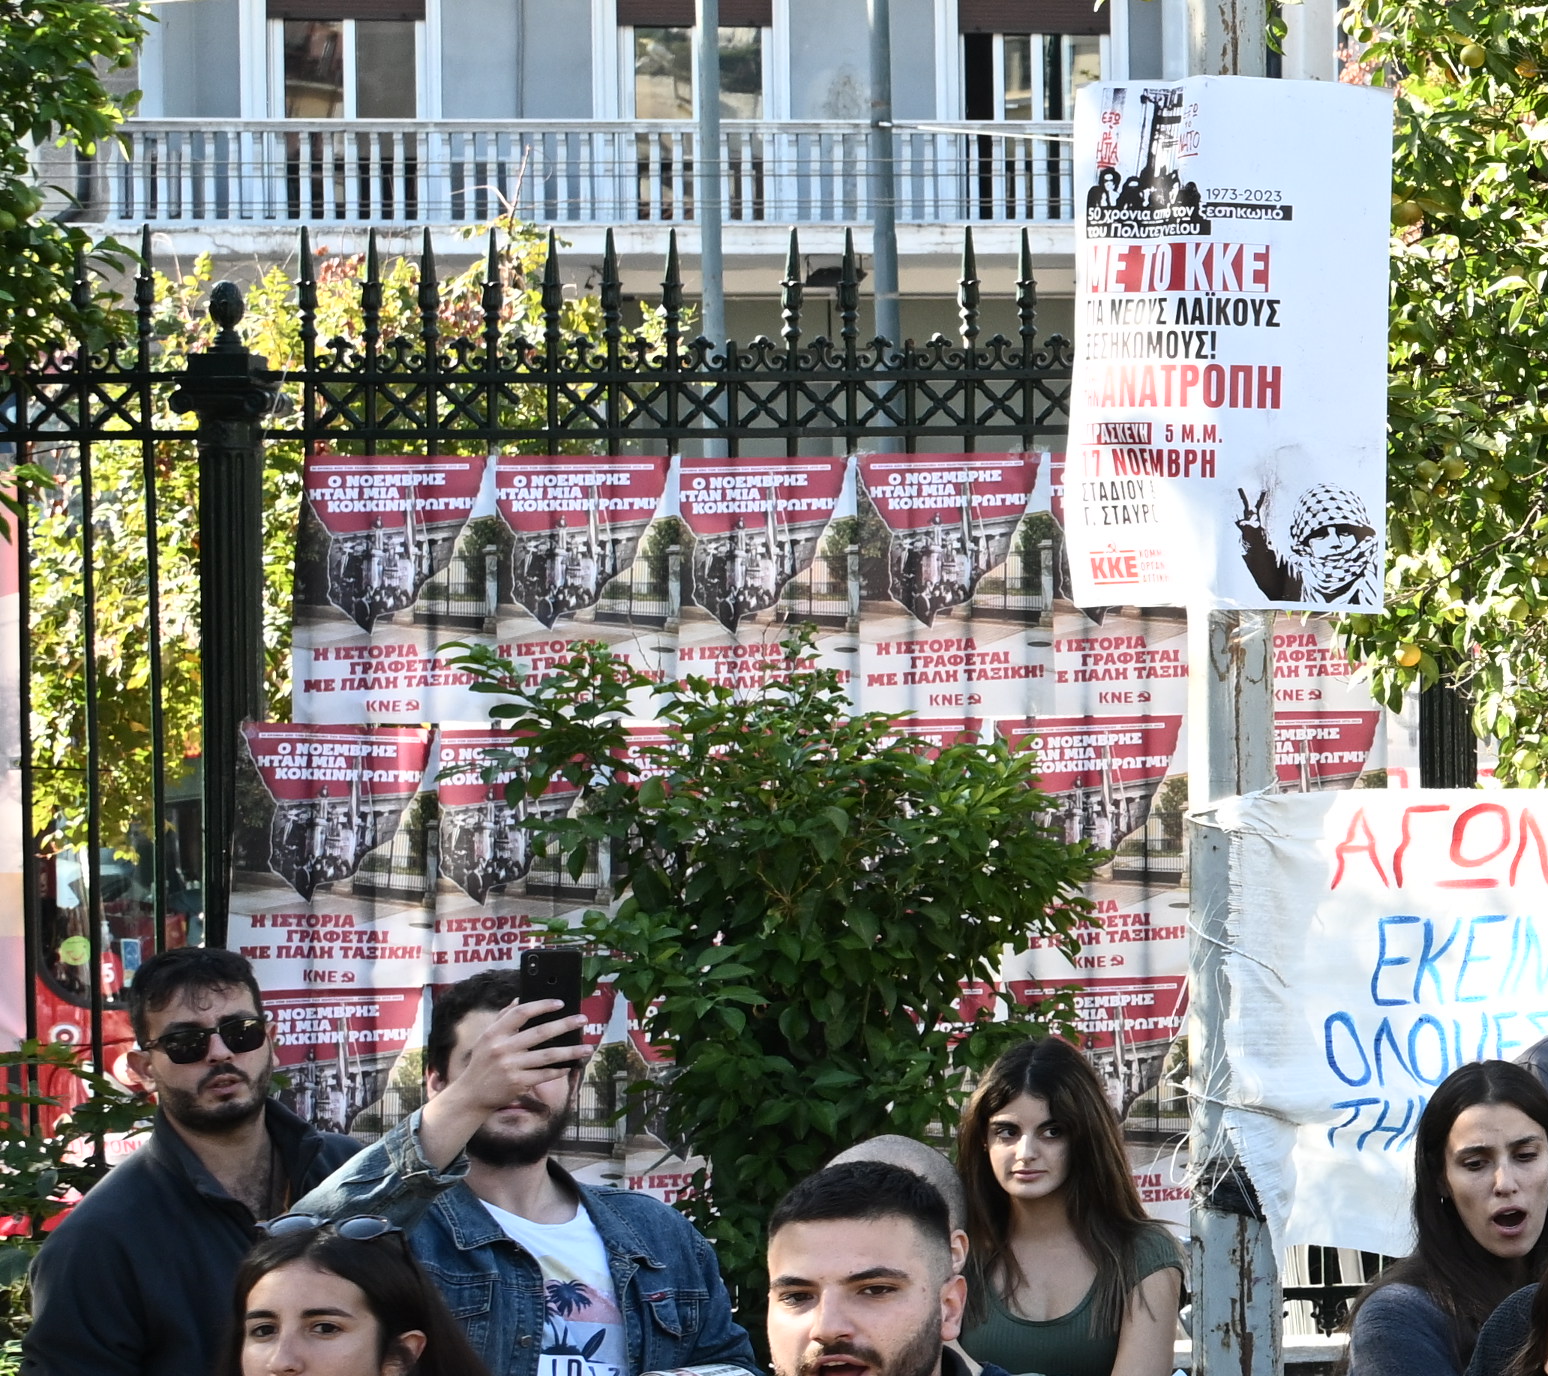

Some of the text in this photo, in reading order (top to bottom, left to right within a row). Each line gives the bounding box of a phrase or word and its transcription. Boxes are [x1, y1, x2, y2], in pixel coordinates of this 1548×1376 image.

[1206, 188, 1282, 202] 1973-2023
[1088, 207, 1102, 221] 50
[1103, 206, 1150, 223] χρόνια
[1172, 206, 1194, 219] τον
[1199, 204, 1283, 221] ξεσηκωμό
[1087, 222, 1200, 238] του Πολυτεχνείου
[1088, 243, 1266, 292] ΜΕ ΤΟ ΚΚΕ
[1110, 298, 1167, 325] ΝΕΟΥΣ
[1175, 292, 1281, 327] ΛΑΪΚΟΥΣ
[1086, 331, 1217, 360] ΞΕΣΗΚΩΜΟΥΣ!
[1101, 364, 1281, 409] ΑΝΑΤΡΟΠΗ
[1166, 424, 1173, 443] 5
[1182, 424, 1223, 443] Μ.Μ.
[1082, 449, 1216, 478] 17 ΝΟΕΜΒΡΗ
[889, 470, 1002, 484] Ο ΝΟΕΜΒΡΗΣ
[870, 486, 955, 498] ΗΤΑΝ ΜΙΑ
[1082, 481, 1144, 501] ΣΤΑΔΙΟΥ
[888, 494, 1030, 510] ΚΟΚΚΙΝΗ ΡΩΓΜΗ
[1090, 556, 1138, 579] ΚΚΕ
[876, 638, 976, 655] Η ΙΣΤΟΡΙΑ
[911, 651, 1010, 669] ΓΡΑΦΕΤΑΙ
[867, 664, 1045, 687] ΜΕ ΠΑΛΗ ΤΑΞΙΚΗ!
[929, 694, 964, 706] ΚΝΕ
